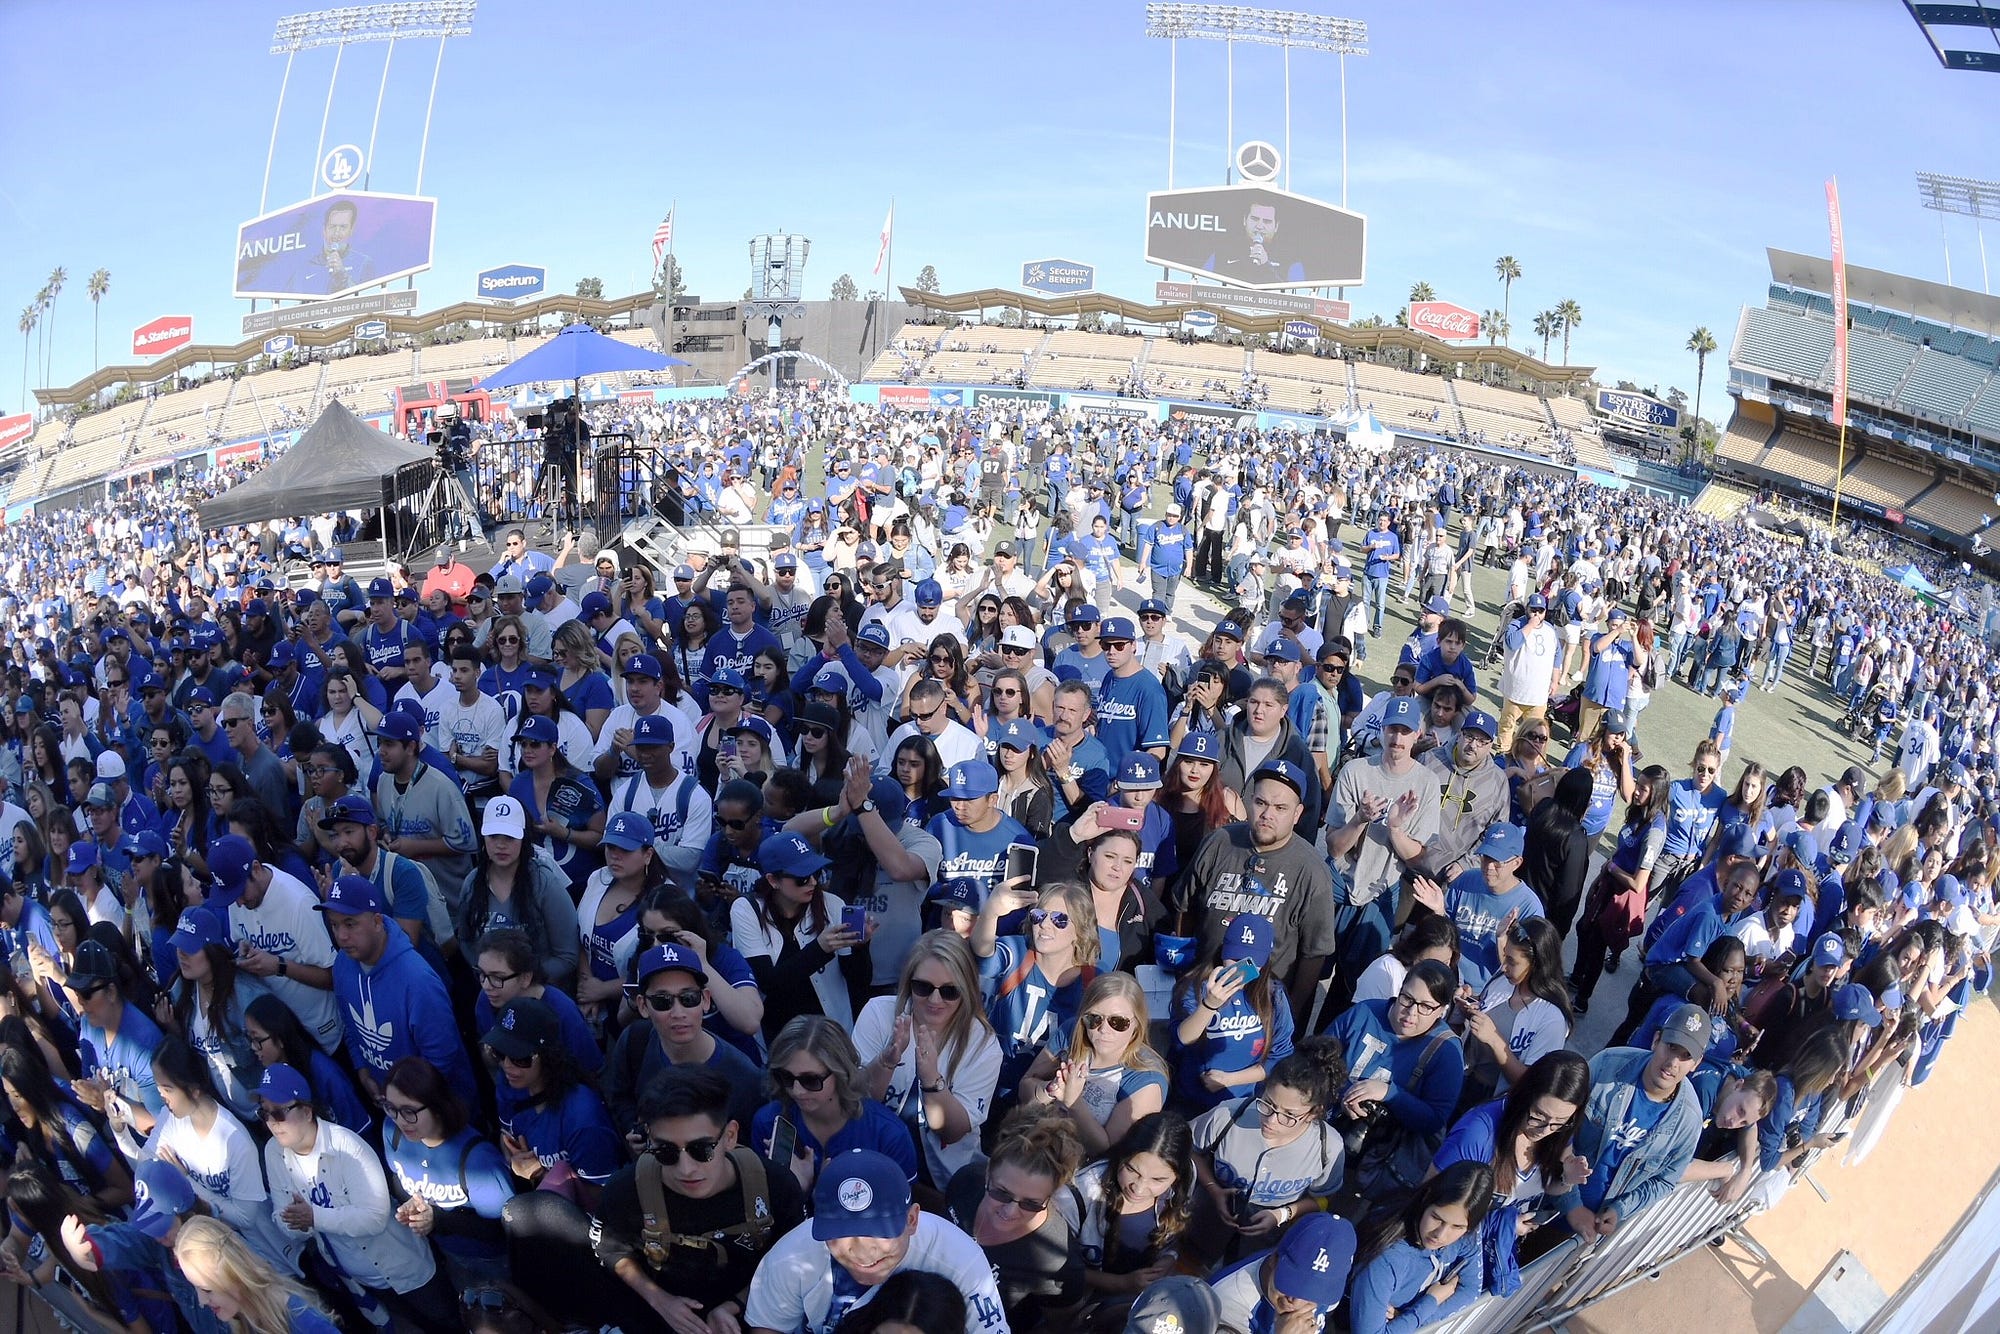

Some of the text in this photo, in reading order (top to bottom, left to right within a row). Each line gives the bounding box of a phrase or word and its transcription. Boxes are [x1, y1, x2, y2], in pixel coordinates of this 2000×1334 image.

[332, 152, 352, 180] LA
[1150, 212, 1226, 232] ANUEL
[240, 232, 306, 260] ANUEL
[1050, 267, 1089, 276] SECURITY
[482, 276, 536, 290] Spectrum
[1159, 290, 1189, 298] Emirates
[1196, 291, 1231, 300] WELCOME
[278, 310, 309, 322] WELCOME
[1415, 307, 1472, 333] Coca-Cola
[1288, 324, 1317, 336] DASANI
[1608, 394, 1668, 417] ESTRELLA
[1613, 404, 1662, 424] JALISCO
[984, 461, 1000, 474] 87
[1048, 462, 1060, 472] 66
[1801, 481, 1828, 496] WELCOME
[1074, 606, 1082, 616] LA
[1107, 622, 1116, 632] LA
[1010, 630, 1018, 640] LA
[1274, 640, 1282, 650] LA
[370, 644, 402, 664] Dodgers
[634, 658, 642, 668] LA
[718, 670, 728, 680] LA
[1398, 701, 1408, 714] B
[379, 714, 386, 727] LA
[525, 718, 534, 730] D
[640, 721, 650, 733] LA
[742, 717, 750, 726] LA
[1476, 714, 1484, 726] LA
[1008, 723, 1018, 734] LA
[1196, 737, 1206, 752] B
[1909, 738, 1924, 758] 34
[682, 754, 694, 776] LA
[1134, 762, 1146, 778] LA
[1276, 760, 1287, 774] LA
[956, 768, 966, 784] LA
[496, 803, 510, 818] D
[615, 820, 625, 832] LA
[791, 838, 808, 854] LA
[69, 850, 77, 862] LA
[211, 872, 225, 886] LA
[1217, 873, 1243, 889] FLY
[1274, 873, 1288, 896] LA
[1794, 874, 1802, 888] LA
[331, 882, 342, 899] LA
[953, 880, 968, 898] LA
[1207, 892, 1286, 916] PENNANT
[240, 923, 296, 954] Dodgers
[1241, 926, 1255, 944] LA
[662, 944, 678, 962] LA
[502, 1008, 515, 1030] LA
[261, 1070, 271, 1084] LA
[394, 1160, 468, 1208] Dodgers
[842, 1186, 868, 1203] Dodgers
[1312, 1248, 1330, 1272] LA
[971, 1293, 1002, 1328] LA
